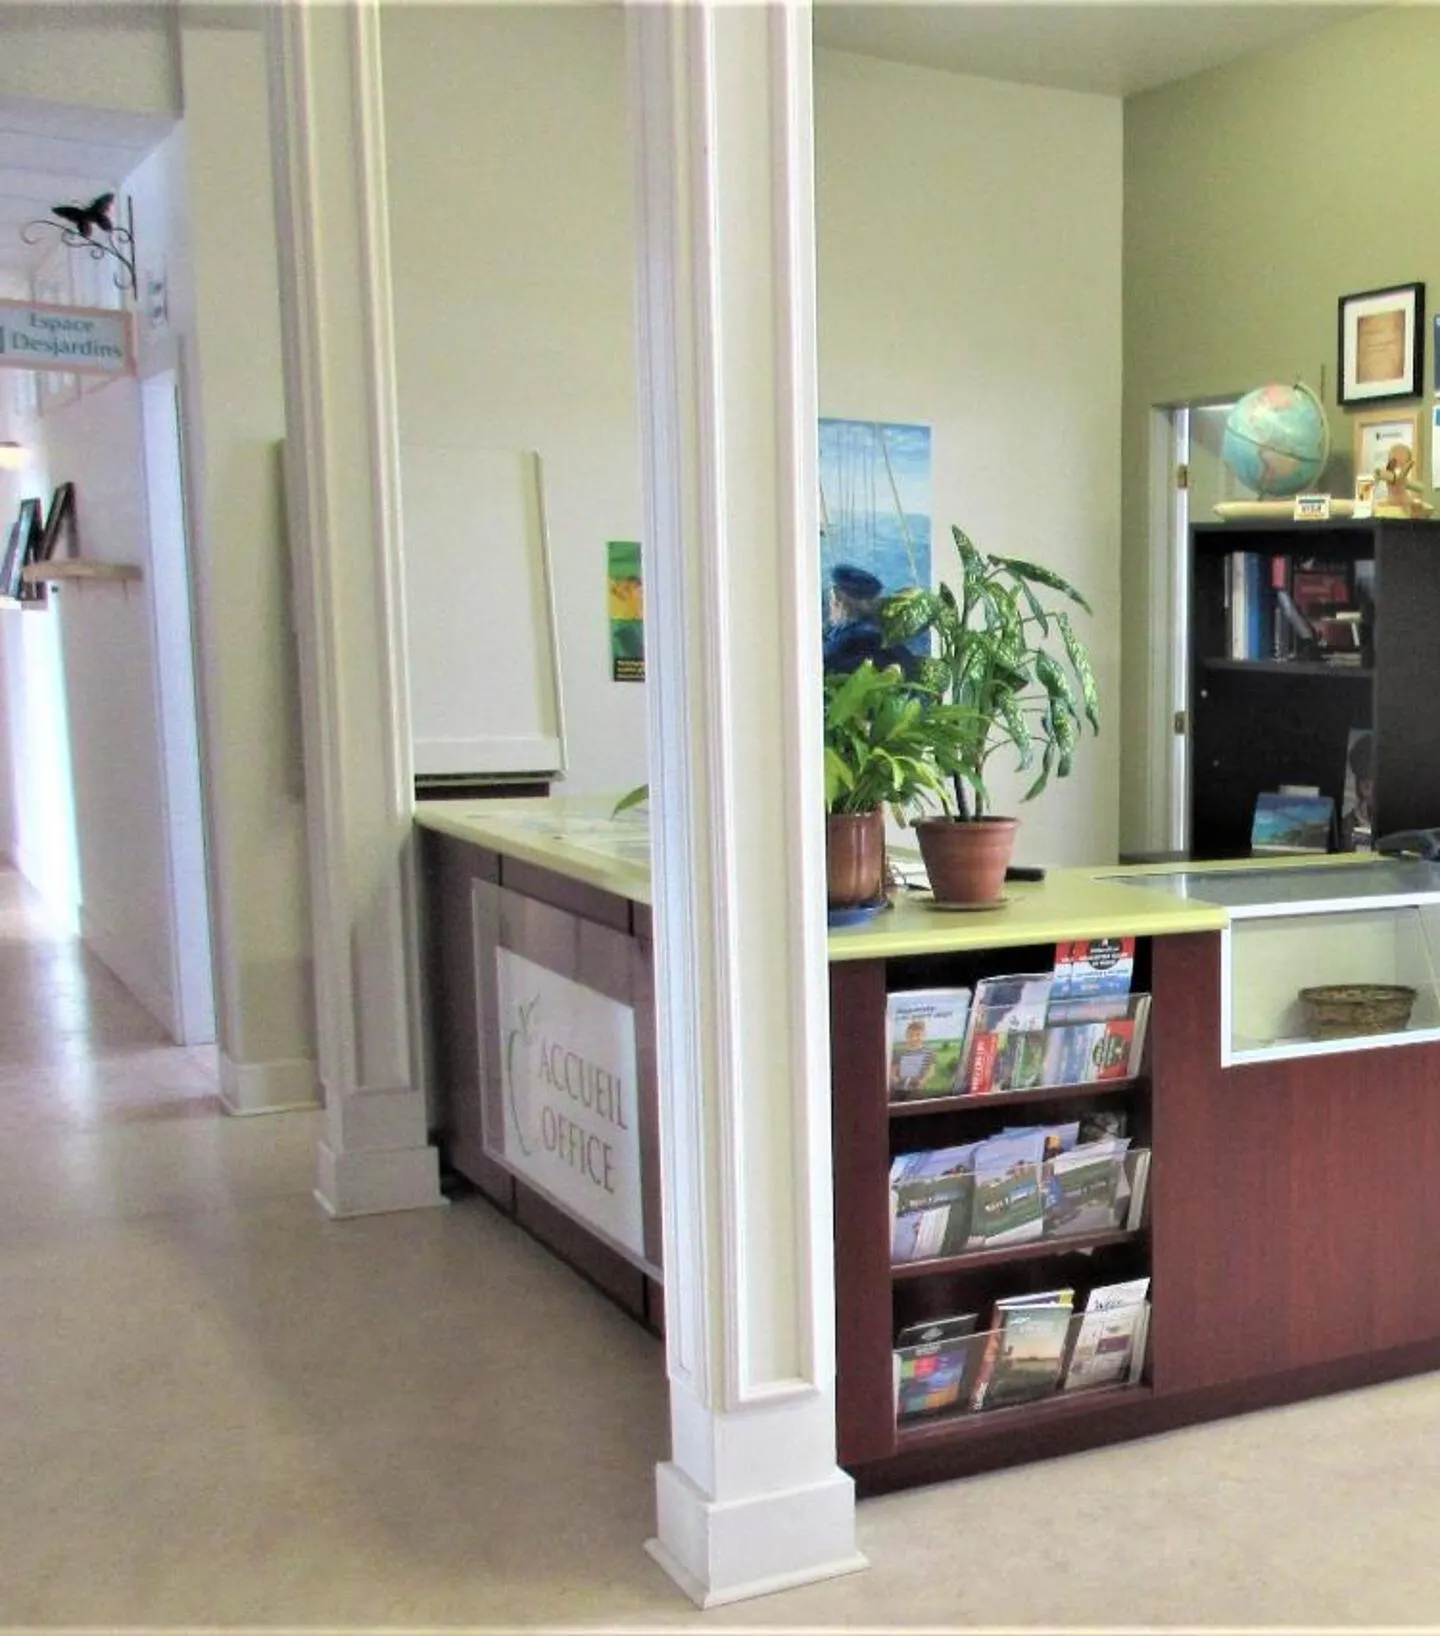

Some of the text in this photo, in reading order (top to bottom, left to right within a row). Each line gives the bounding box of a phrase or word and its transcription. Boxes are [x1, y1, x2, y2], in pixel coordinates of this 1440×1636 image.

[12, 331, 123, 357] Desjardins
[29, 312, 95, 333] Espace
[539, 1038, 628, 1130] ACCUEIL
[541, 1105, 615, 1194] OFFICE
